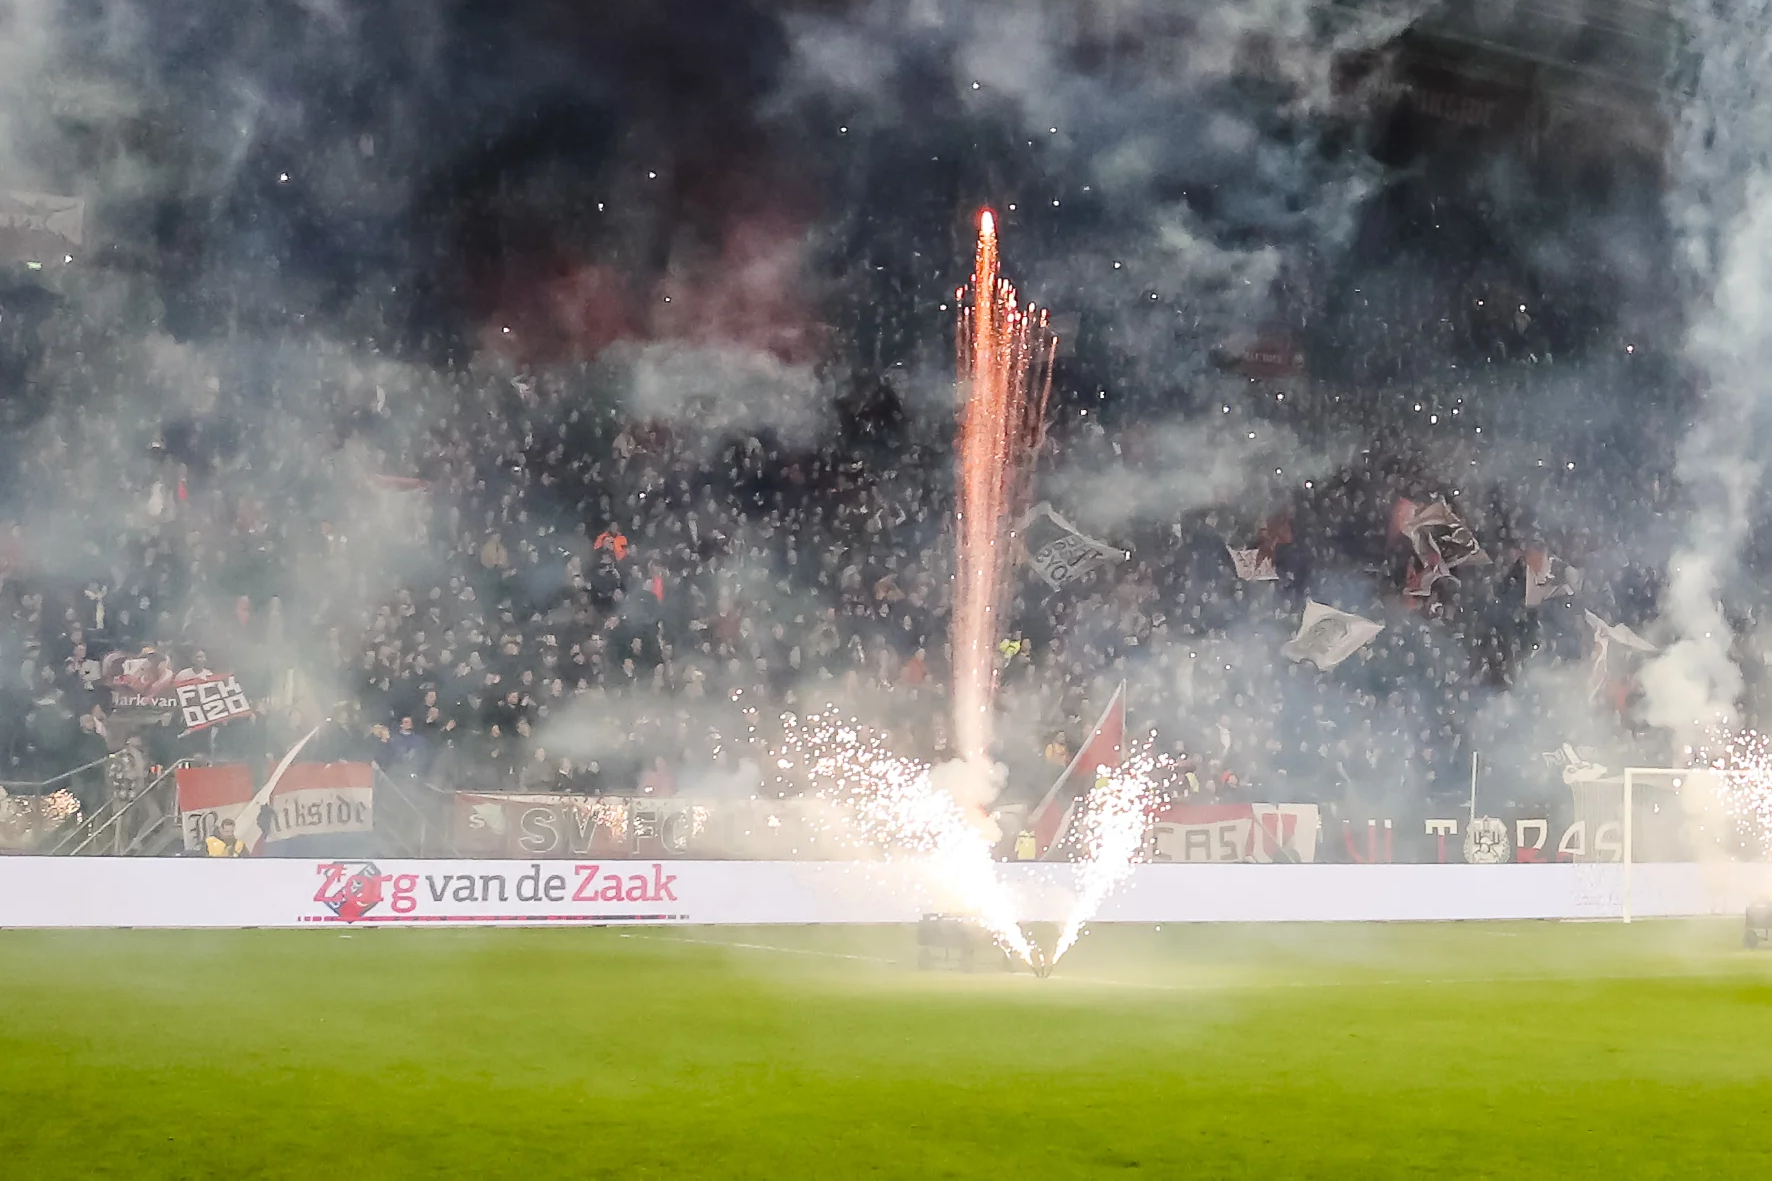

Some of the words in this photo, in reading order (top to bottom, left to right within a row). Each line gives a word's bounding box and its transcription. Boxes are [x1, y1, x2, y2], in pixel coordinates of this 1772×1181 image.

[150, 697, 177, 707] van
[313, 864, 420, 913] Zorg
[425, 874, 508, 902] van
[516, 864, 567, 902] de
[572, 864, 678, 902] Zaak
